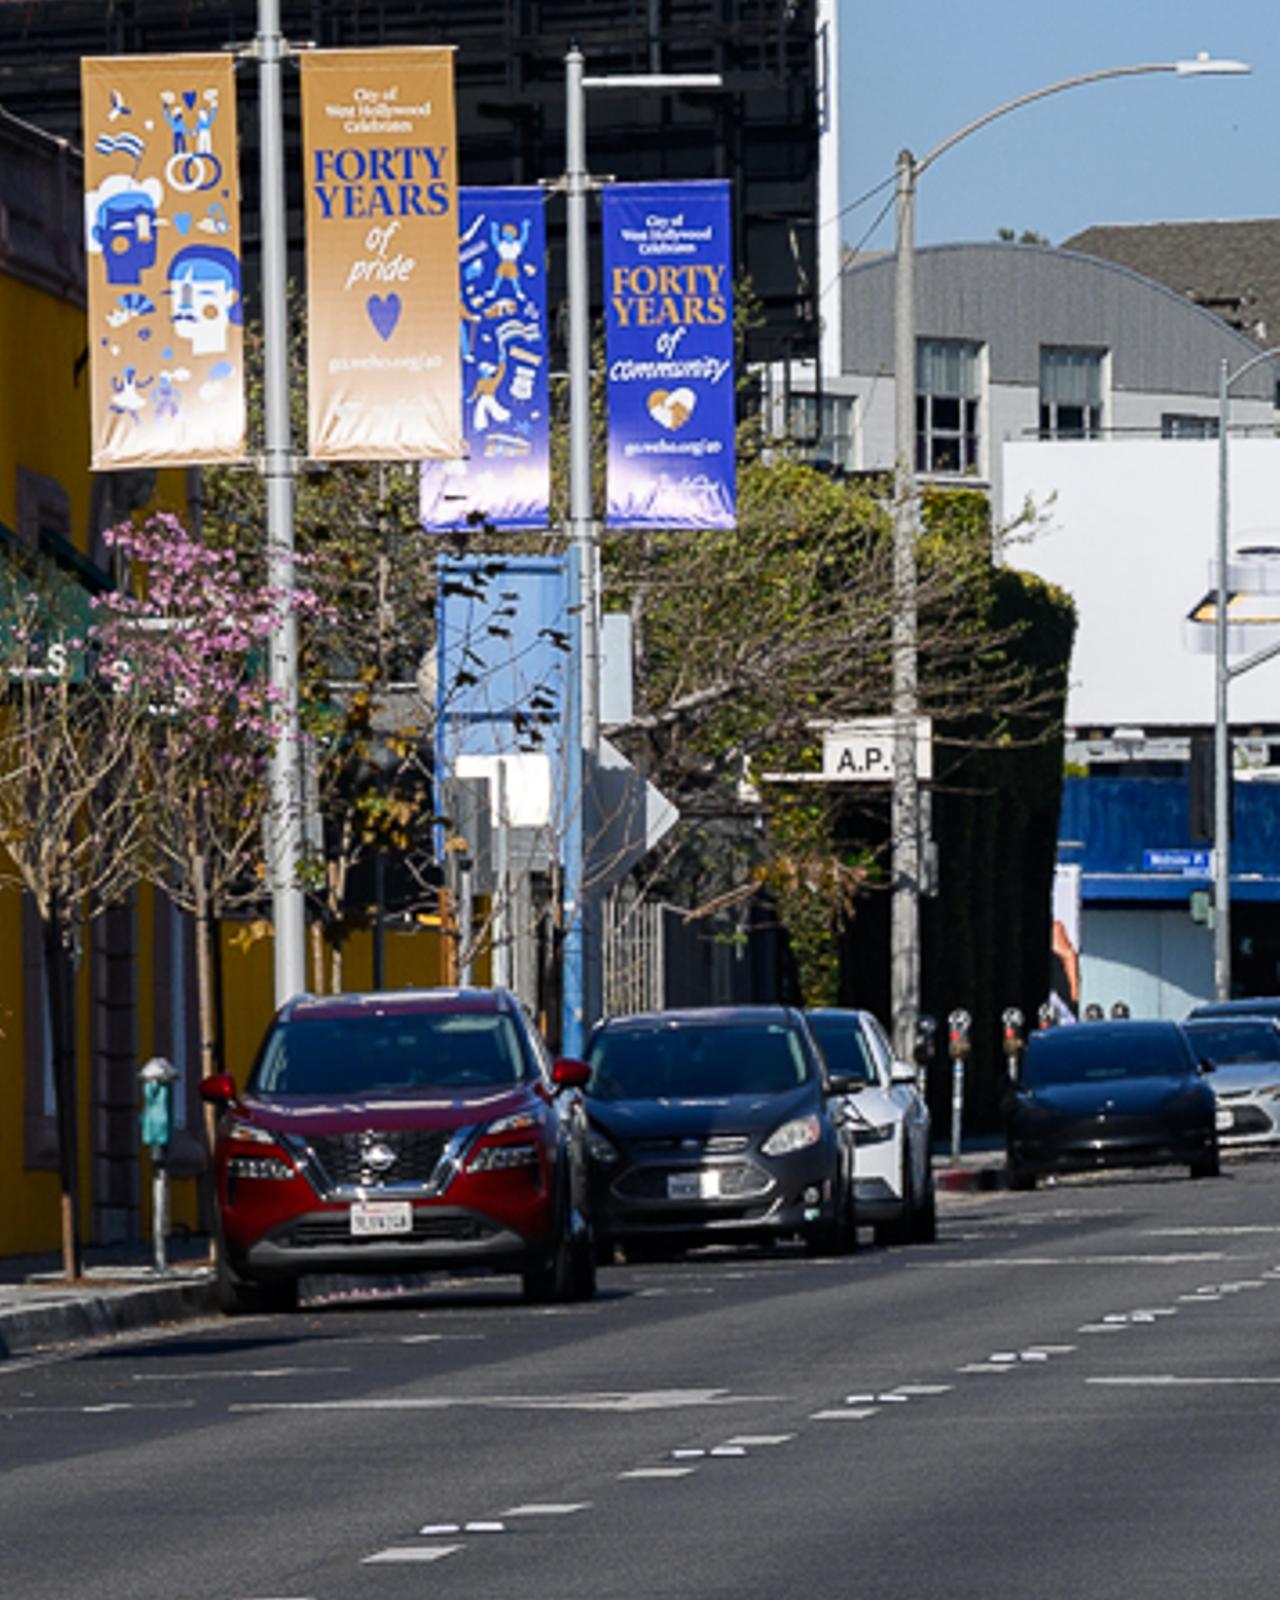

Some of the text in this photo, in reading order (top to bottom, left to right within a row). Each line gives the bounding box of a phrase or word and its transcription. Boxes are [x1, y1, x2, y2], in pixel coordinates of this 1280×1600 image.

[313, 147, 448, 182] FORTY
[313, 182, 450, 218] YEARS
[365, 221, 400, 256] of
[345, 254, 416, 290] pride
[612, 265, 726, 295] FORTY
[611, 295, 727, 326] YEARS
[656, 326, 686, 359] of
[609, 356, 731, 385] community
[837, 747, 896, 773] A.P.
